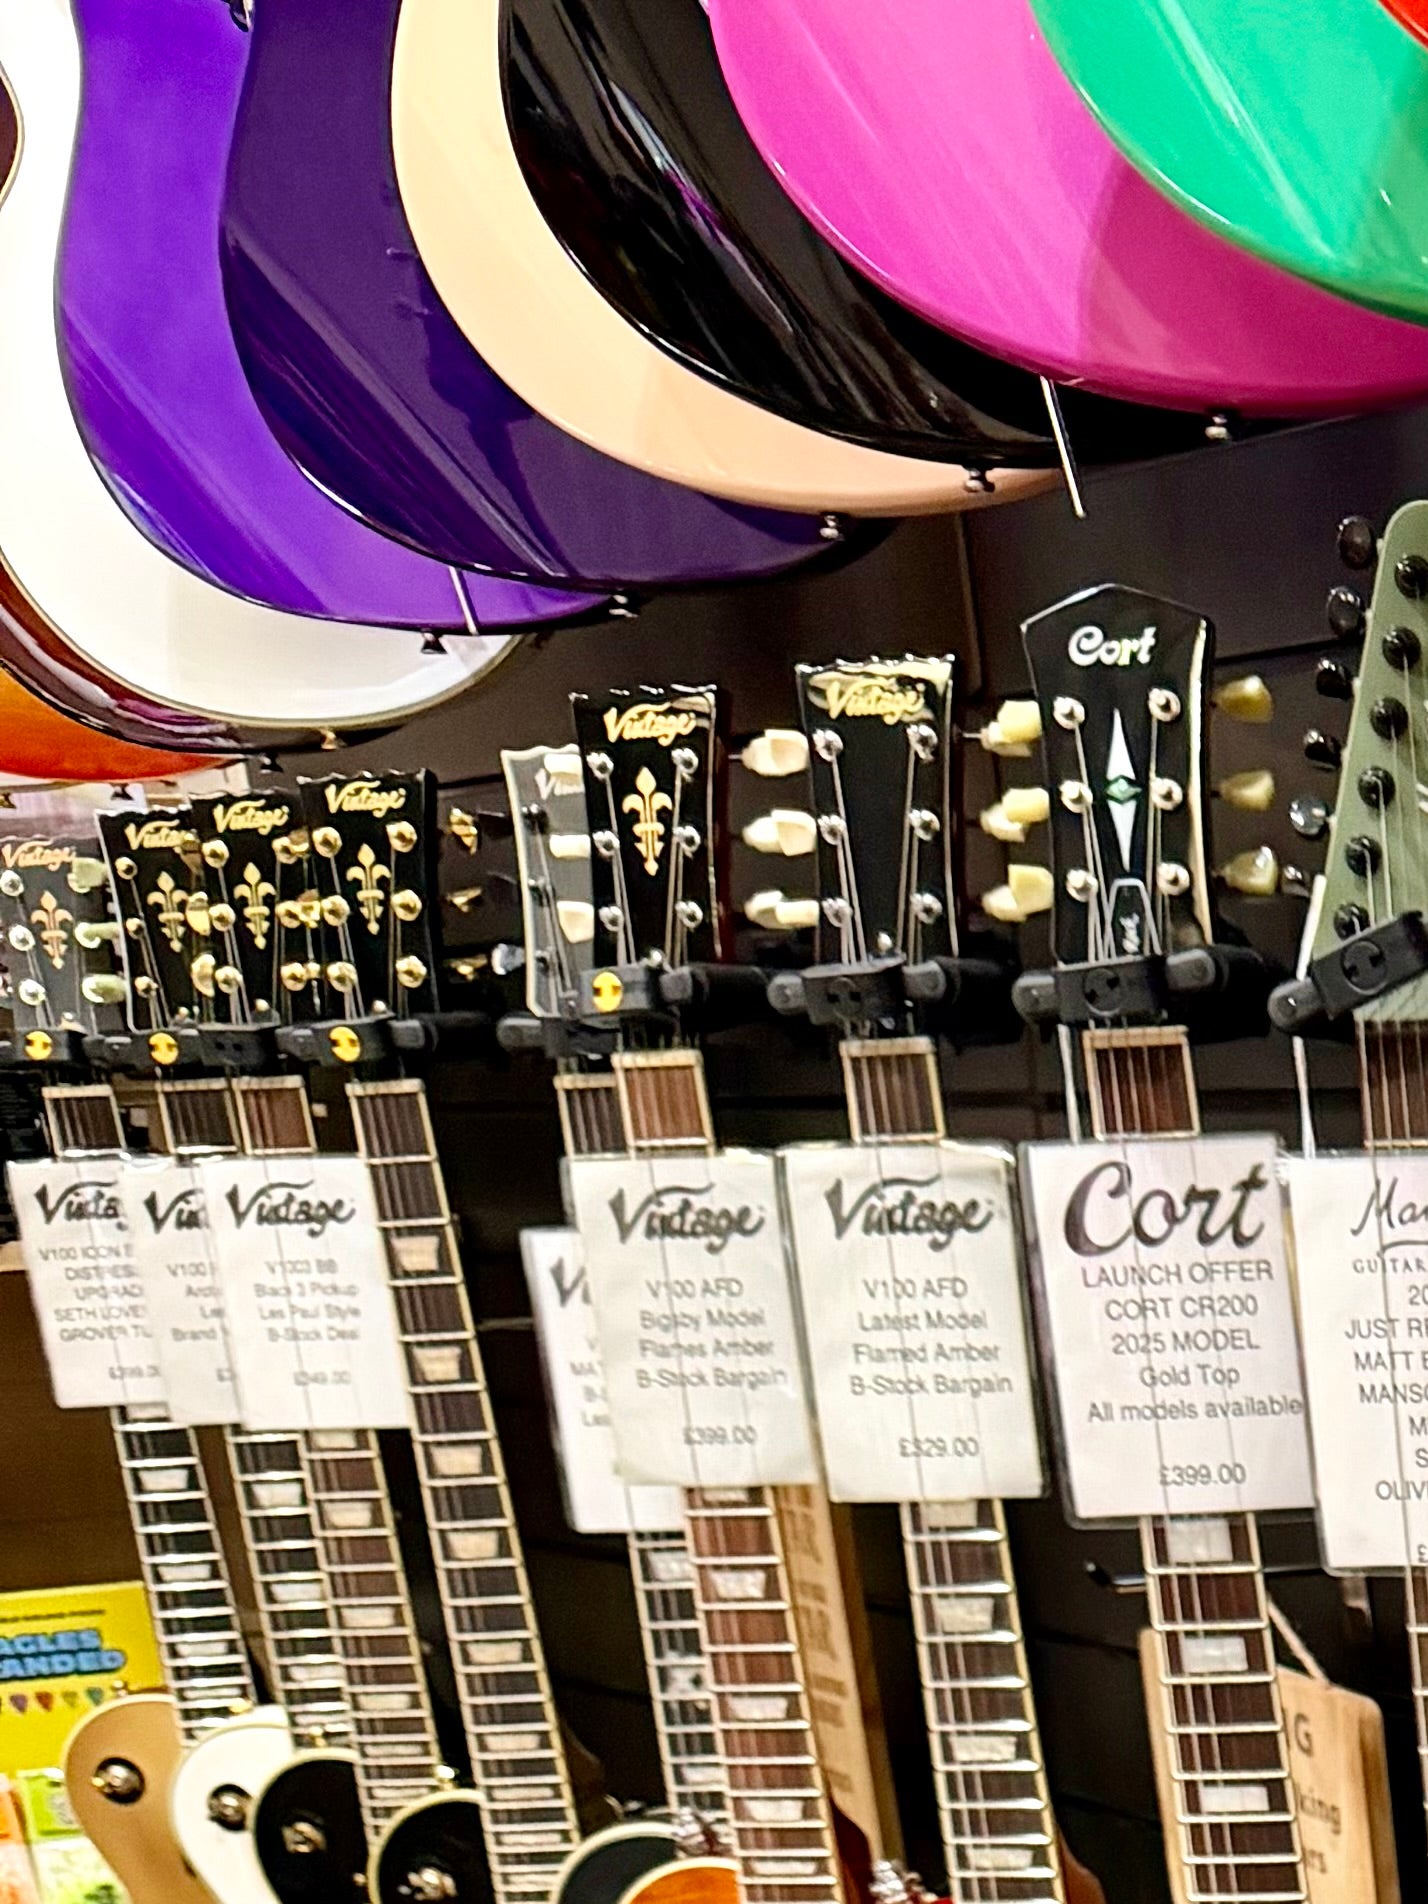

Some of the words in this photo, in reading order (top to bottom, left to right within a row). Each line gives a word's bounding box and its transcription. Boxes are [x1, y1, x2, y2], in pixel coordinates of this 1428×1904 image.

[1068, 625, 1156, 667] Cort
[825, 678, 925, 725] Vintage
[603, 704, 696, 747] Vintage
[324, 780, 406, 818] Vintage
[212, 799, 289, 835] Vintage
[225, 1180, 356, 1238] Vintage
[609, 1182, 766, 1255] Vintage
[824, 1175, 994, 1252] Vintage
[1064, 1160, 1271, 1257] Cort
[1082, 1262, 1182, 1288] LAUNCH
[1188, 1260, 1273, 1284] OFFER
[1352, 1255, 1427, 1275] GUITAR
[859, 1311, 921, 1331] Latest
[926, 1311, 987, 1330] Model
[1104, 1296, 1177, 1322] CORT
[1182, 1294, 1258, 1318] CR200
[1112, 1331, 1167, 1355] 2025
[1172, 1329, 1260, 1352] MODEL
[1345, 1318, 1400, 1341] JUST
[854, 1344, 927, 1364] Flamed
[932, 1344, 1000, 1363] Amber
[1354, 1350, 1414, 1373] MATT
[638, 1369, 707, 1389] B-Stock
[715, 1370, 788, 1391] Bargain
[851, 1376, 928, 1396] B-Stock
[935, 1376, 1013, 1399] Bargain
[1141, 1366, 1192, 1389] Gold
[1202, 1365, 1240, 1389] Top
[1088, 1400, 1115, 1421] All
[1121, 1399, 1199, 1421] models
[1205, 1397, 1303, 1419] available
[1159, 1463, 1247, 1487] £399.00
